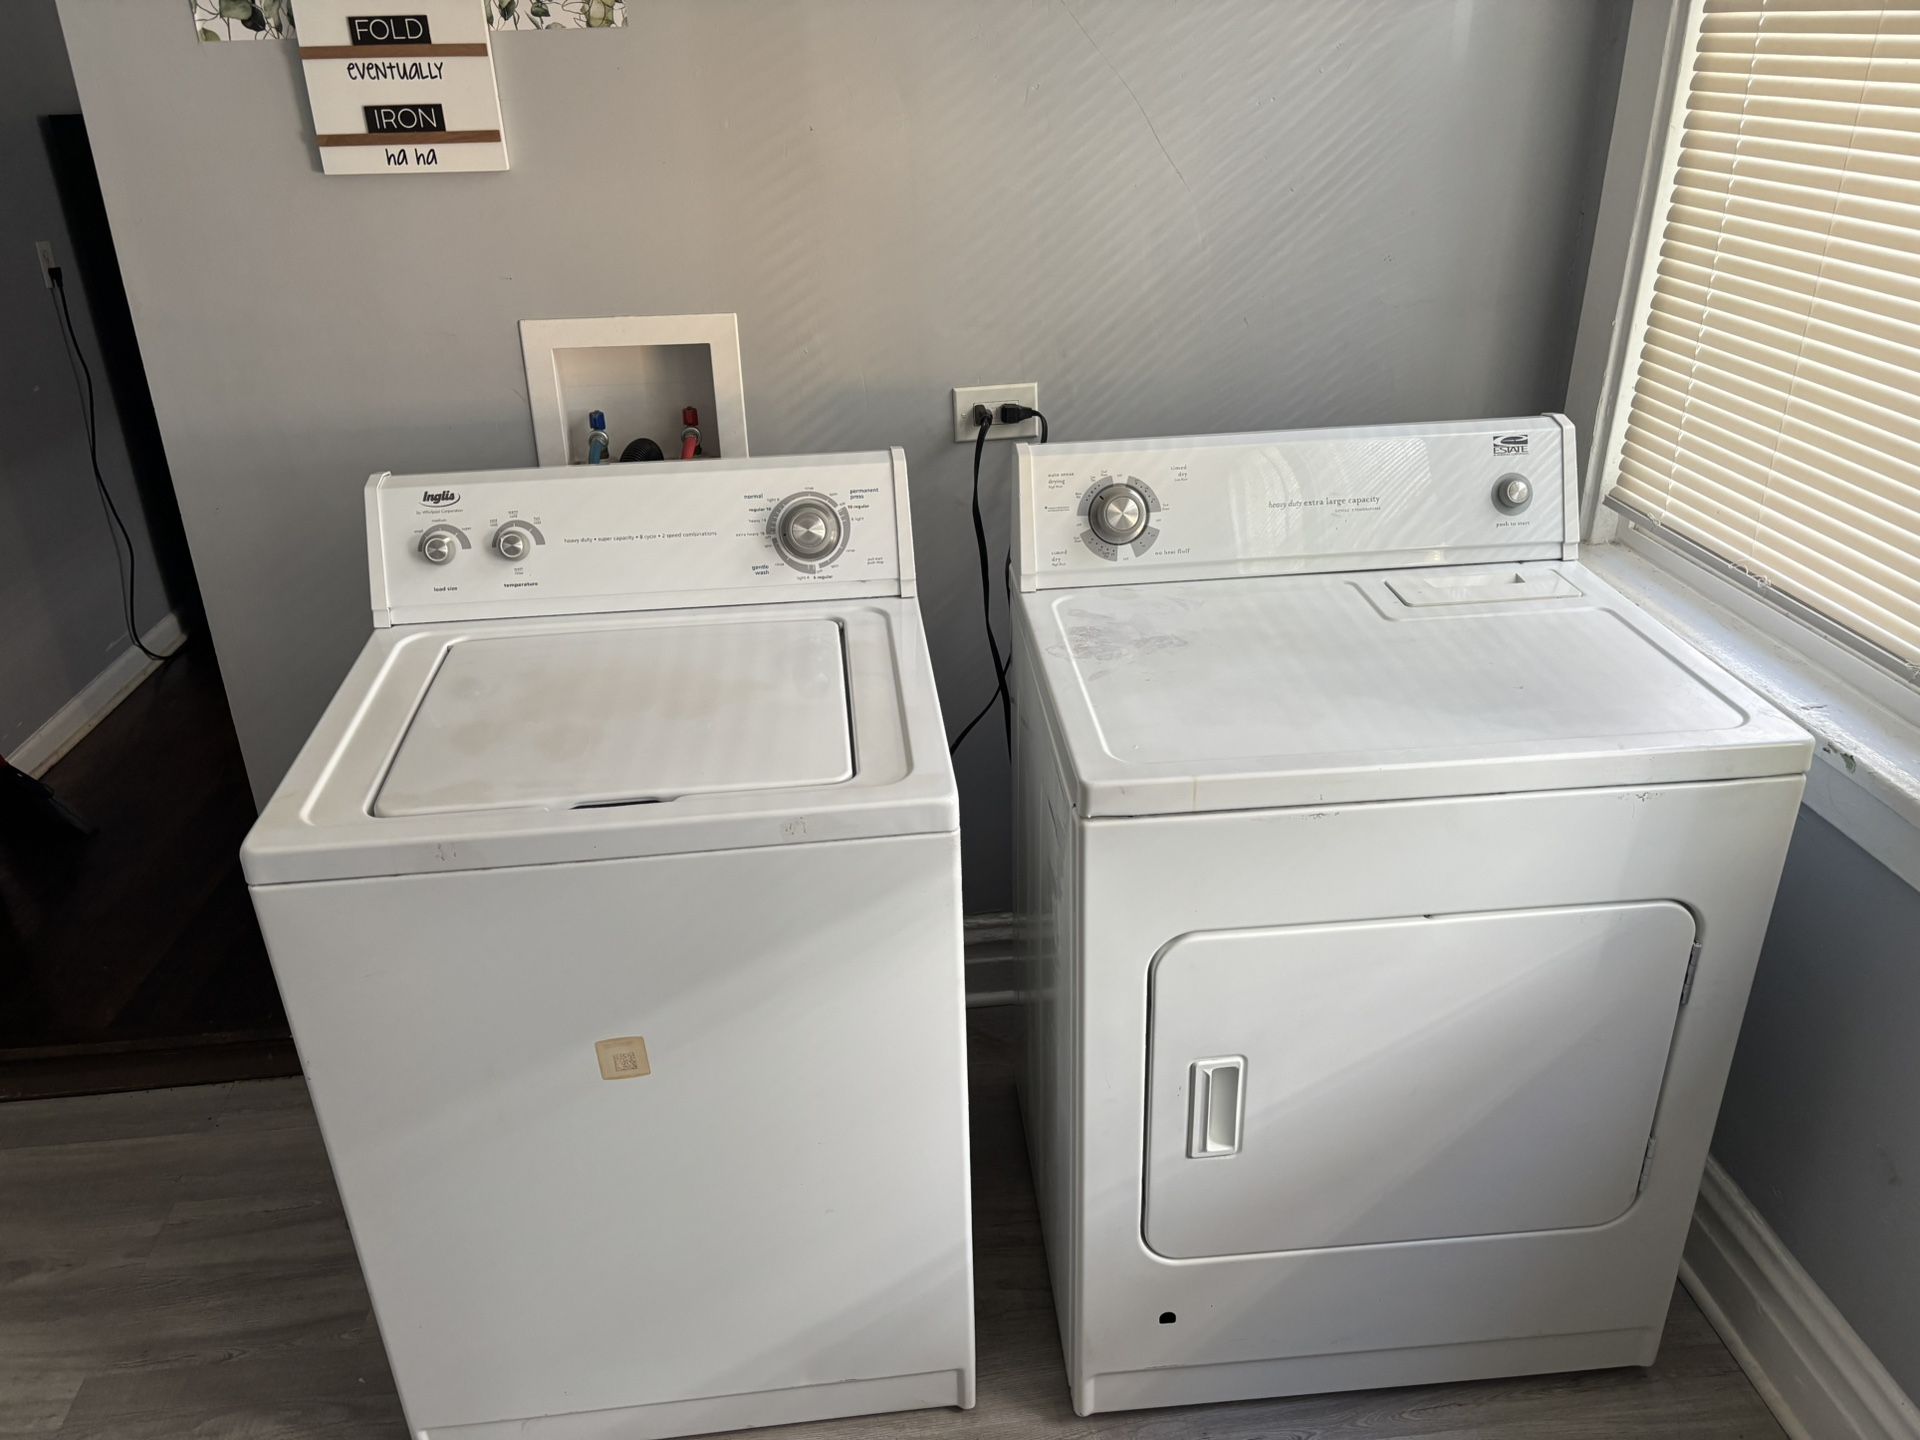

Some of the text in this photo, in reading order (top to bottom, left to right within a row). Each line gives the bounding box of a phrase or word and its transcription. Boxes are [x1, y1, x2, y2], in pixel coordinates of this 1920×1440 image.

[355, 19, 423, 41] FOLD
[374, 107, 437, 130] IRON
[386, 148, 437, 166] ha ha
[1493, 446, 1528, 454] ESTATE
[423, 491, 455, 504] Inglis
[1326, 497, 1346, 505] large
[1348, 496, 1380, 505] capacity
